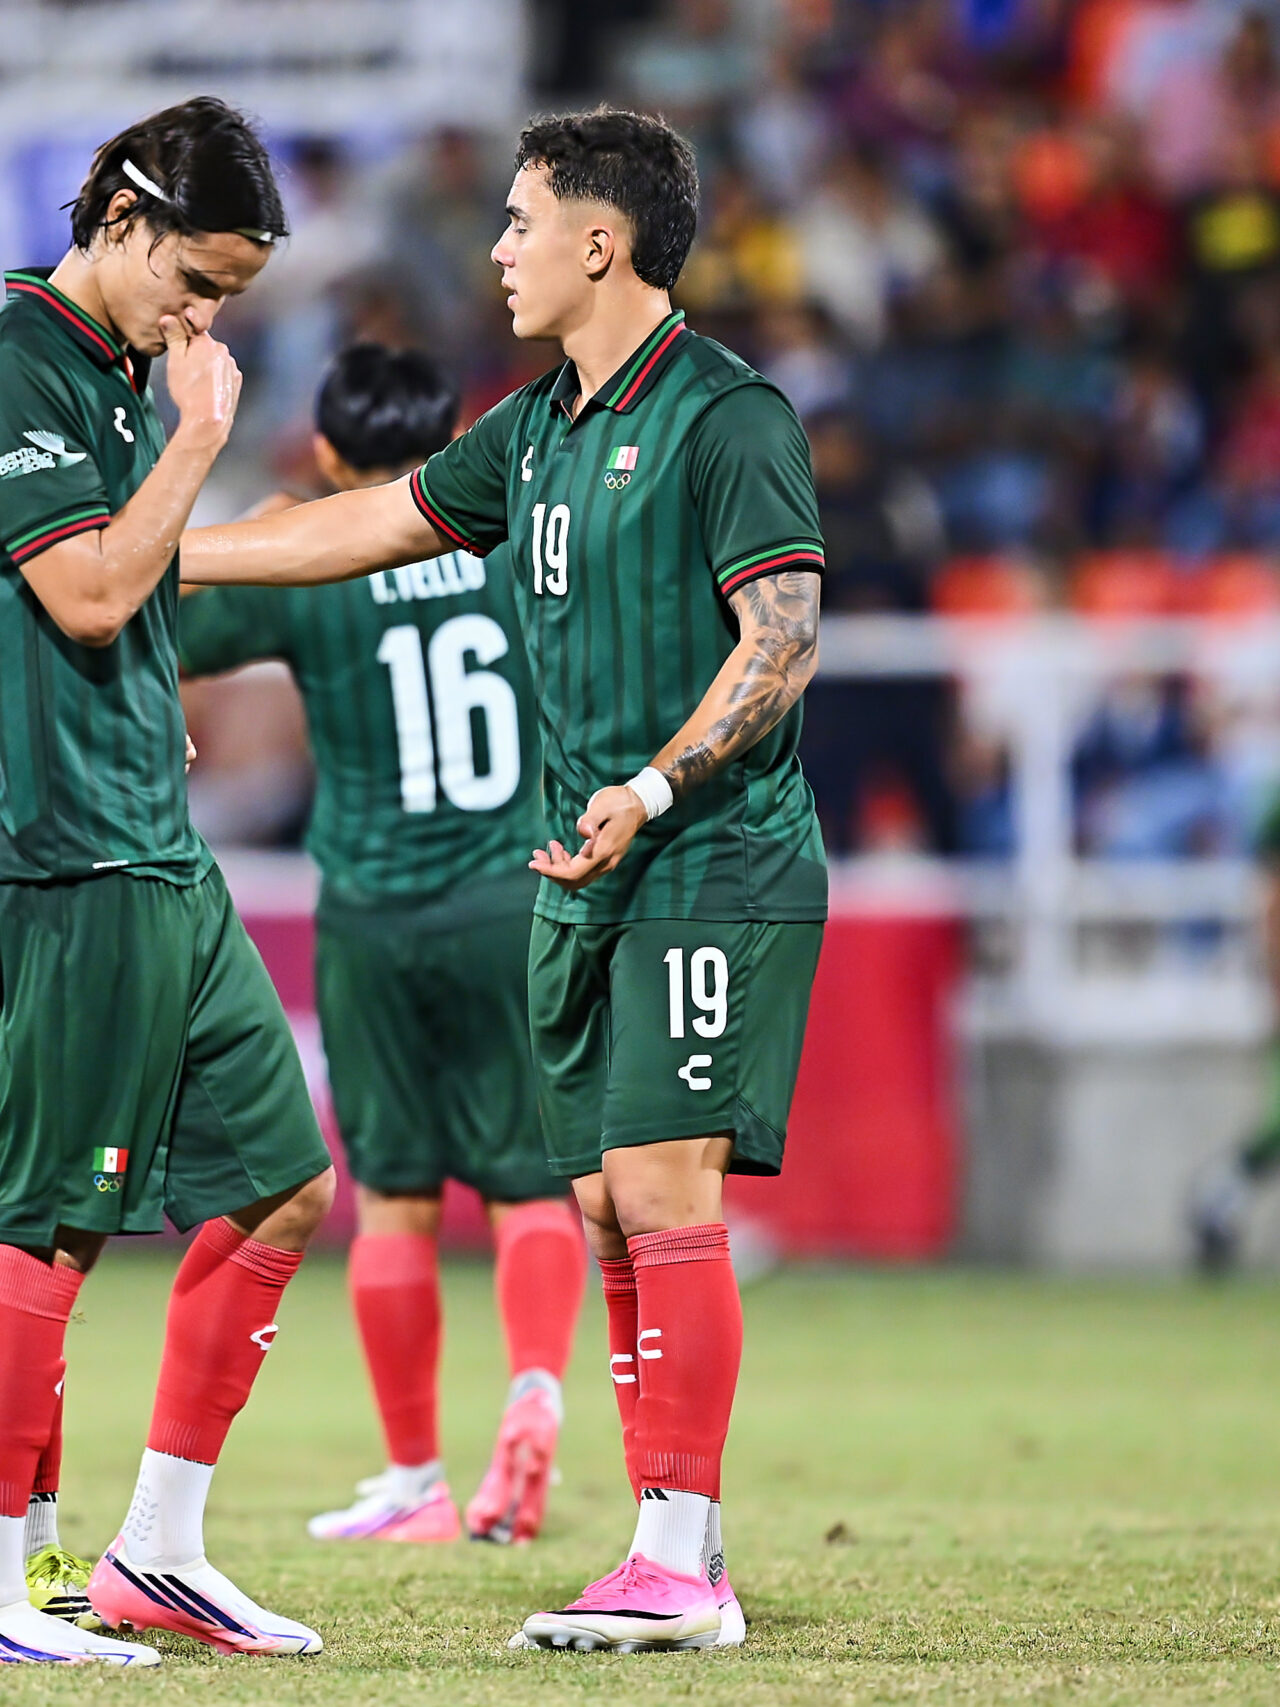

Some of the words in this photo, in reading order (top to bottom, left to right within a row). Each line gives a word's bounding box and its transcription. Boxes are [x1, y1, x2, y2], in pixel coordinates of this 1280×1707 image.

[531, 503, 570, 596] 19
[376, 613, 521, 813] 16
[663, 946, 729, 1039] 19
